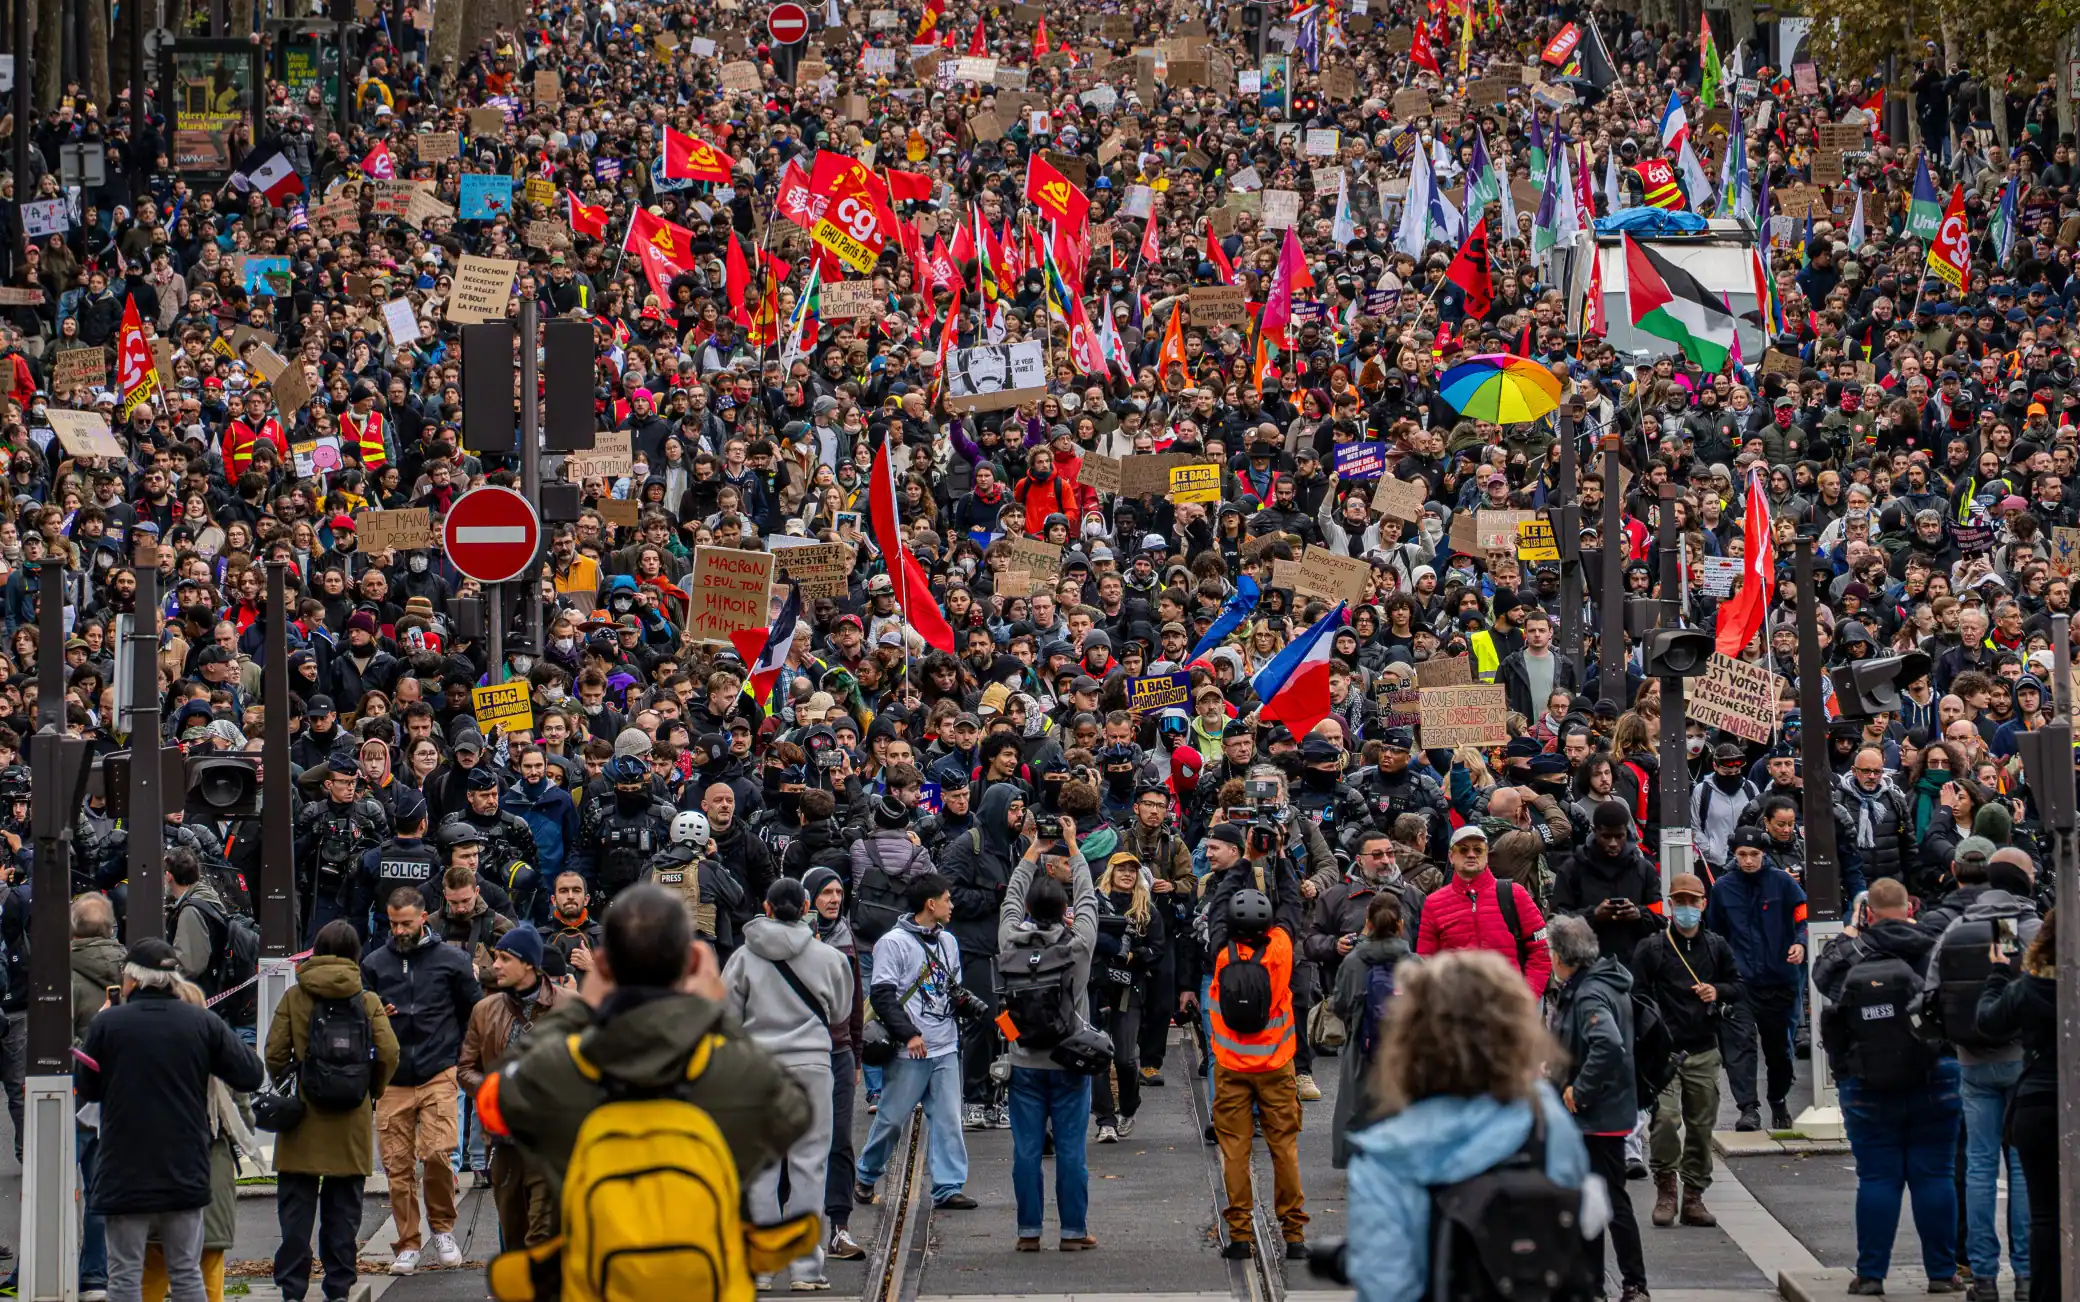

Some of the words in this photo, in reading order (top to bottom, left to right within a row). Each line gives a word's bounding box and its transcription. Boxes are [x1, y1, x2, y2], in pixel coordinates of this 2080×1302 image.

[178, 112, 205, 122] Kerry
[209, 112, 242, 121] James
[178, 121, 223, 130] Marshall
[820, 223, 838, 244] GHU
[839, 236, 861, 260] Paris
[463, 264, 476, 273] LES
[477, 266, 510, 277] COCHONS
[821, 283, 833, 293] LE
[840, 280, 872, 291] ROSEAU
[458, 292, 487, 304] DEBOUT
[851, 290, 873, 301] MAIS
[1221, 289, 1245, 300] PEUPLE
[456, 302, 468, 310] LA
[469, 305, 494, 315] FERME
[857, 303, 873, 314] PAS
[1207, 311, 1237, 320] MOMENT
[58, 348, 104, 363] MANIFESTER
[79, 358, 101, 370] DROIT
[1014, 359, 1022, 368] JE
[1022, 357, 1035, 367] VEUX
[1014, 365, 1029, 374] VIVRE
[1337, 445, 1359, 457] BAISSE
[1346, 452, 1359, 461] DES
[1359, 448, 1373, 457] PRIX
[1338, 458, 1363, 473] HAUSSE
[1362, 455, 1375, 465] DES
[1349, 462, 1378, 476] SALAIRES
[1378, 460, 1383, 468] !
[1176, 472, 1188, 482] LE
[1188, 469, 1210, 481] BAC
[1189, 478, 1219, 490] MATRAQUES
[396, 512, 429, 531] MANU
[1526, 526, 1539, 537] LE
[1541, 526, 1555, 537] BA
[358, 533, 375, 545] TU
[1531, 538, 1540, 547] LES
[799, 547, 841, 557] DIRIGEZ
[833, 554, 840, 564] ?
[1306, 551, 1357, 573] DEMOCRATIE
[1300, 567, 1328, 584] POUVOIR
[1332, 580, 1344, 588] AU
[703, 579, 737, 589] SEUL
[740, 579, 764, 591] TON
[801, 585, 834, 594] FAUSSES
[1308, 581, 1335, 595] PEUPLE
[705, 593, 758, 617] MIROIR
[1719, 656, 1734, 673] LA
[1736, 662, 1782, 690] HAINE
[1136, 680, 1146, 694] À
[1147, 679, 1172, 693] BAS
[1399, 681, 1411, 691] LES
[1709, 667, 1728, 683] ST
[1728, 673, 1766, 698] VOTRE
[479, 693, 493, 706] LE
[492, 690, 516, 705] BAC
[1132, 687, 1187, 708] PARCOURSUP
[1419, 691, 1456, 708] VOUS
[1456, 690, 1503, 708] PRENEZ
[1698, 680, 1768, 710] PROGRAMME
[485, 706, 494, 718] LES
[493, 700, 529, 716] MATRAQUES
[1694, 691, 1708, 705] LA
[1708, 696, 1756, 718] JEUNESSE
[1756, 706, 1774, 725] EST
[1420, 709, 1447, 727] NOS
[1446, 706, 1487, 726] DROITS
[1487, 706, 1505, 723] ON
[1690, 703, 1721, 727] VOTRE
[1420, 727, 1468, 747] REPREND
[1467, 728, 1484, 744] LA
[1483, 725, 1505, 742] RUE
[381, 862, 429, 878] POLICE
[661, 873, 683, 883] PRESS
[1863, 1004, 1893, 1019] PRESS
